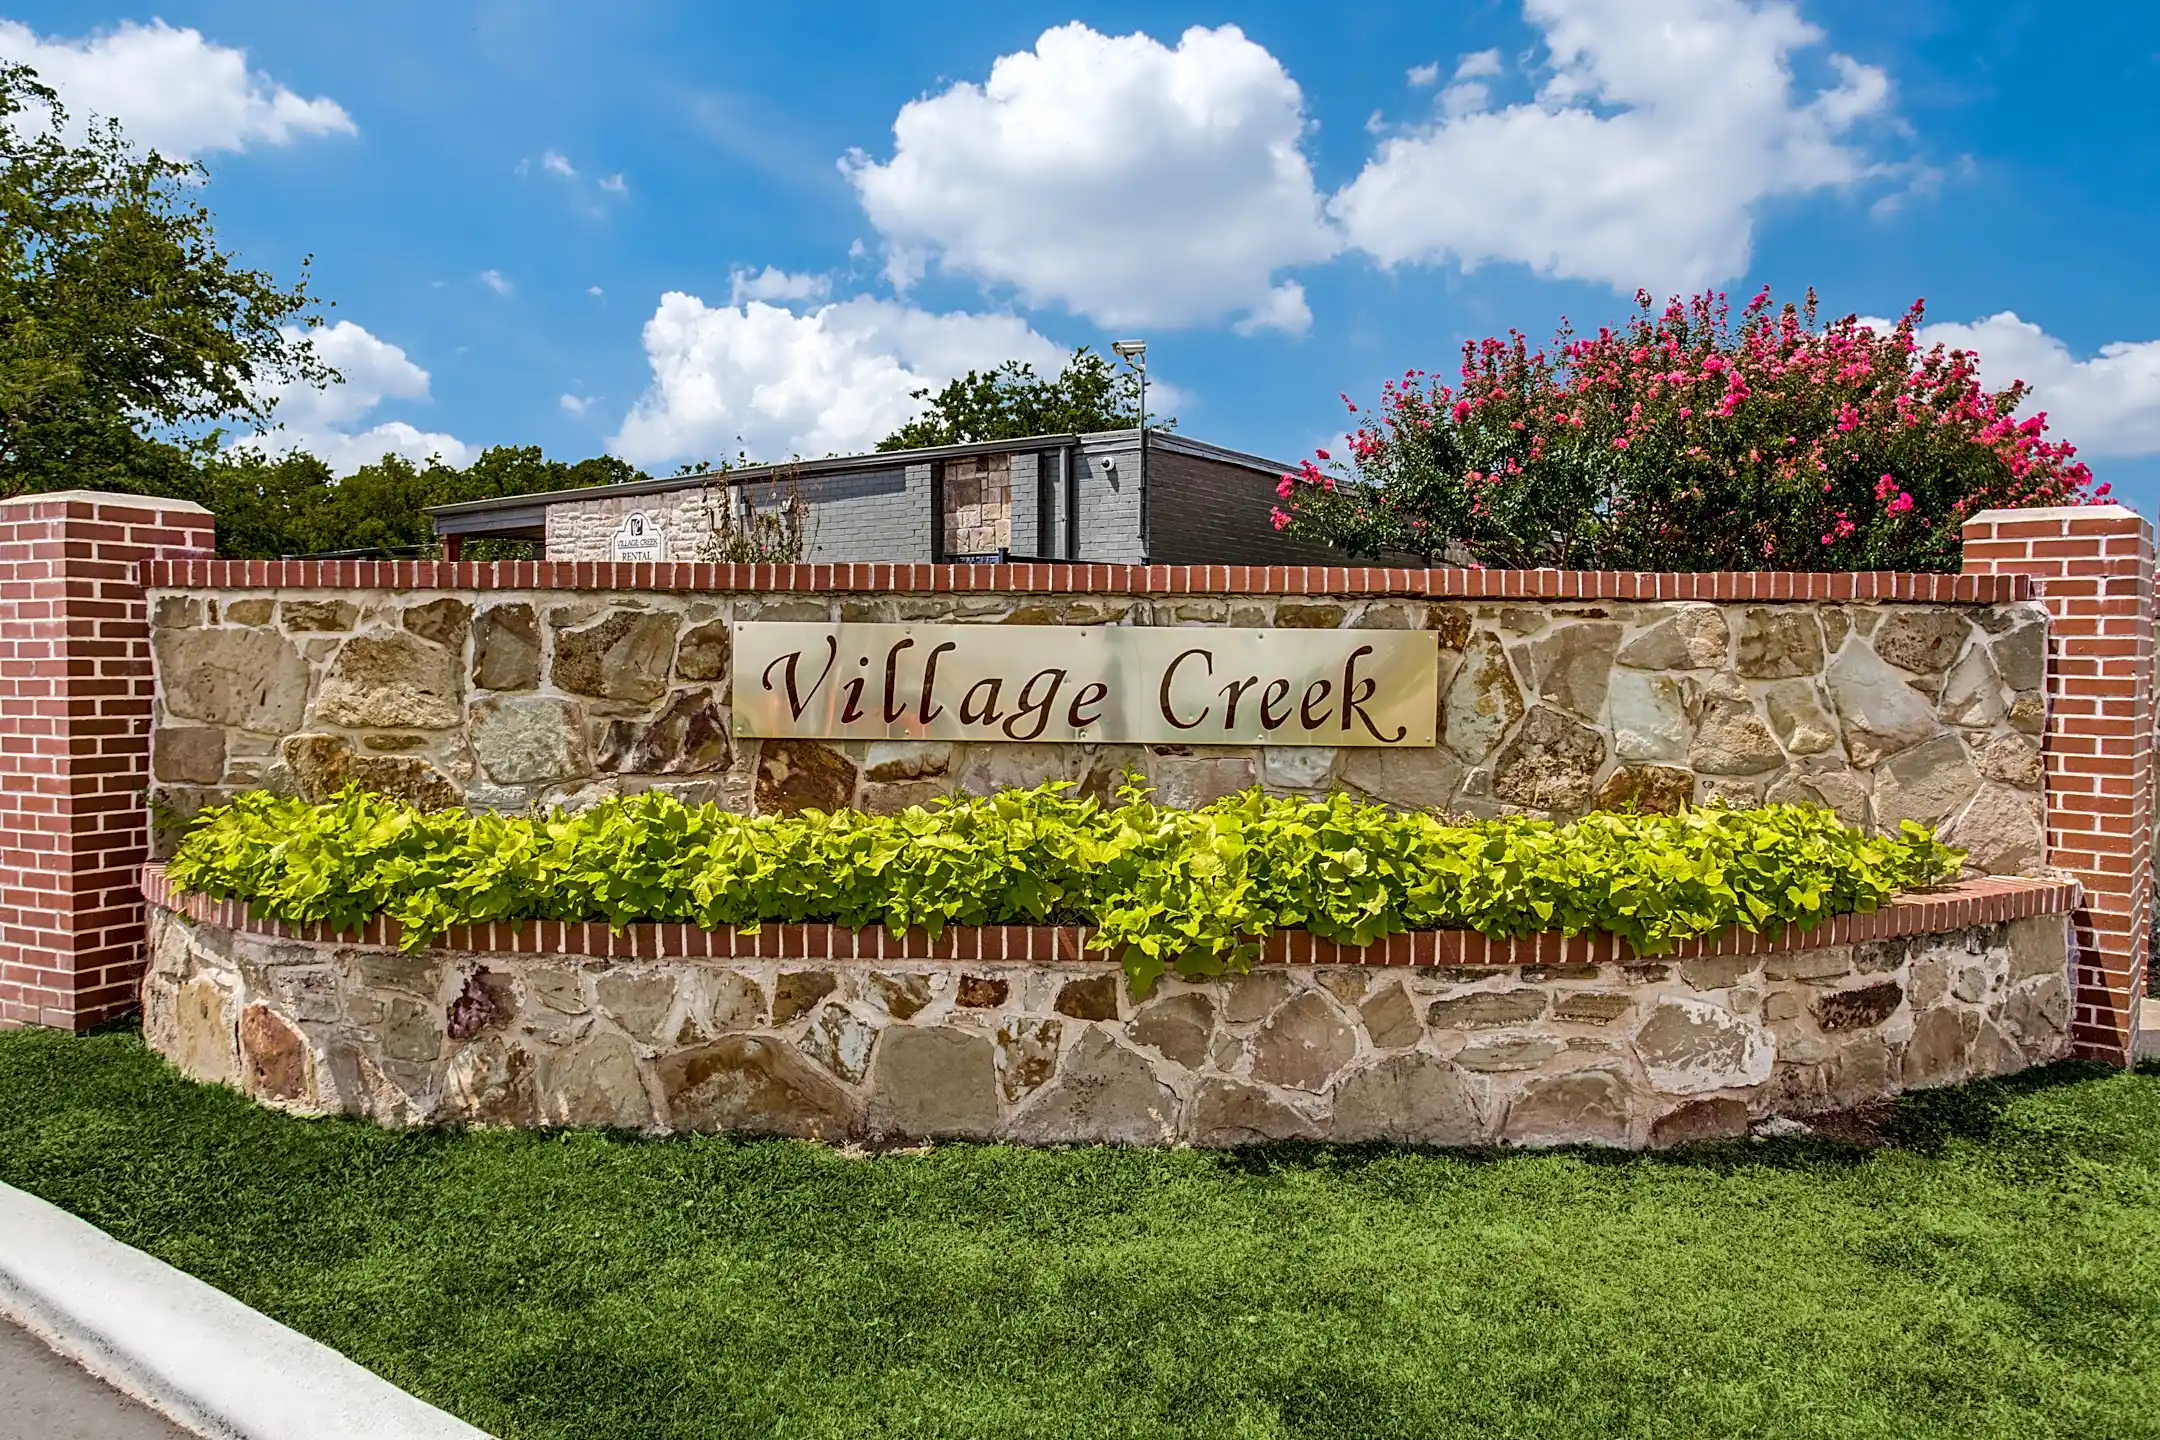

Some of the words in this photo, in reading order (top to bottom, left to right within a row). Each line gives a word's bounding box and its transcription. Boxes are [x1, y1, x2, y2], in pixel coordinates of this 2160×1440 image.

[617, 539, 639, 547] VILLAGE
[640, 538, 658, 546] CREEK
[622, 551, 652, 561] RENTAL
[763, 635, 1109, 740] Village
[1160, 645, 1408, 743] Creek
